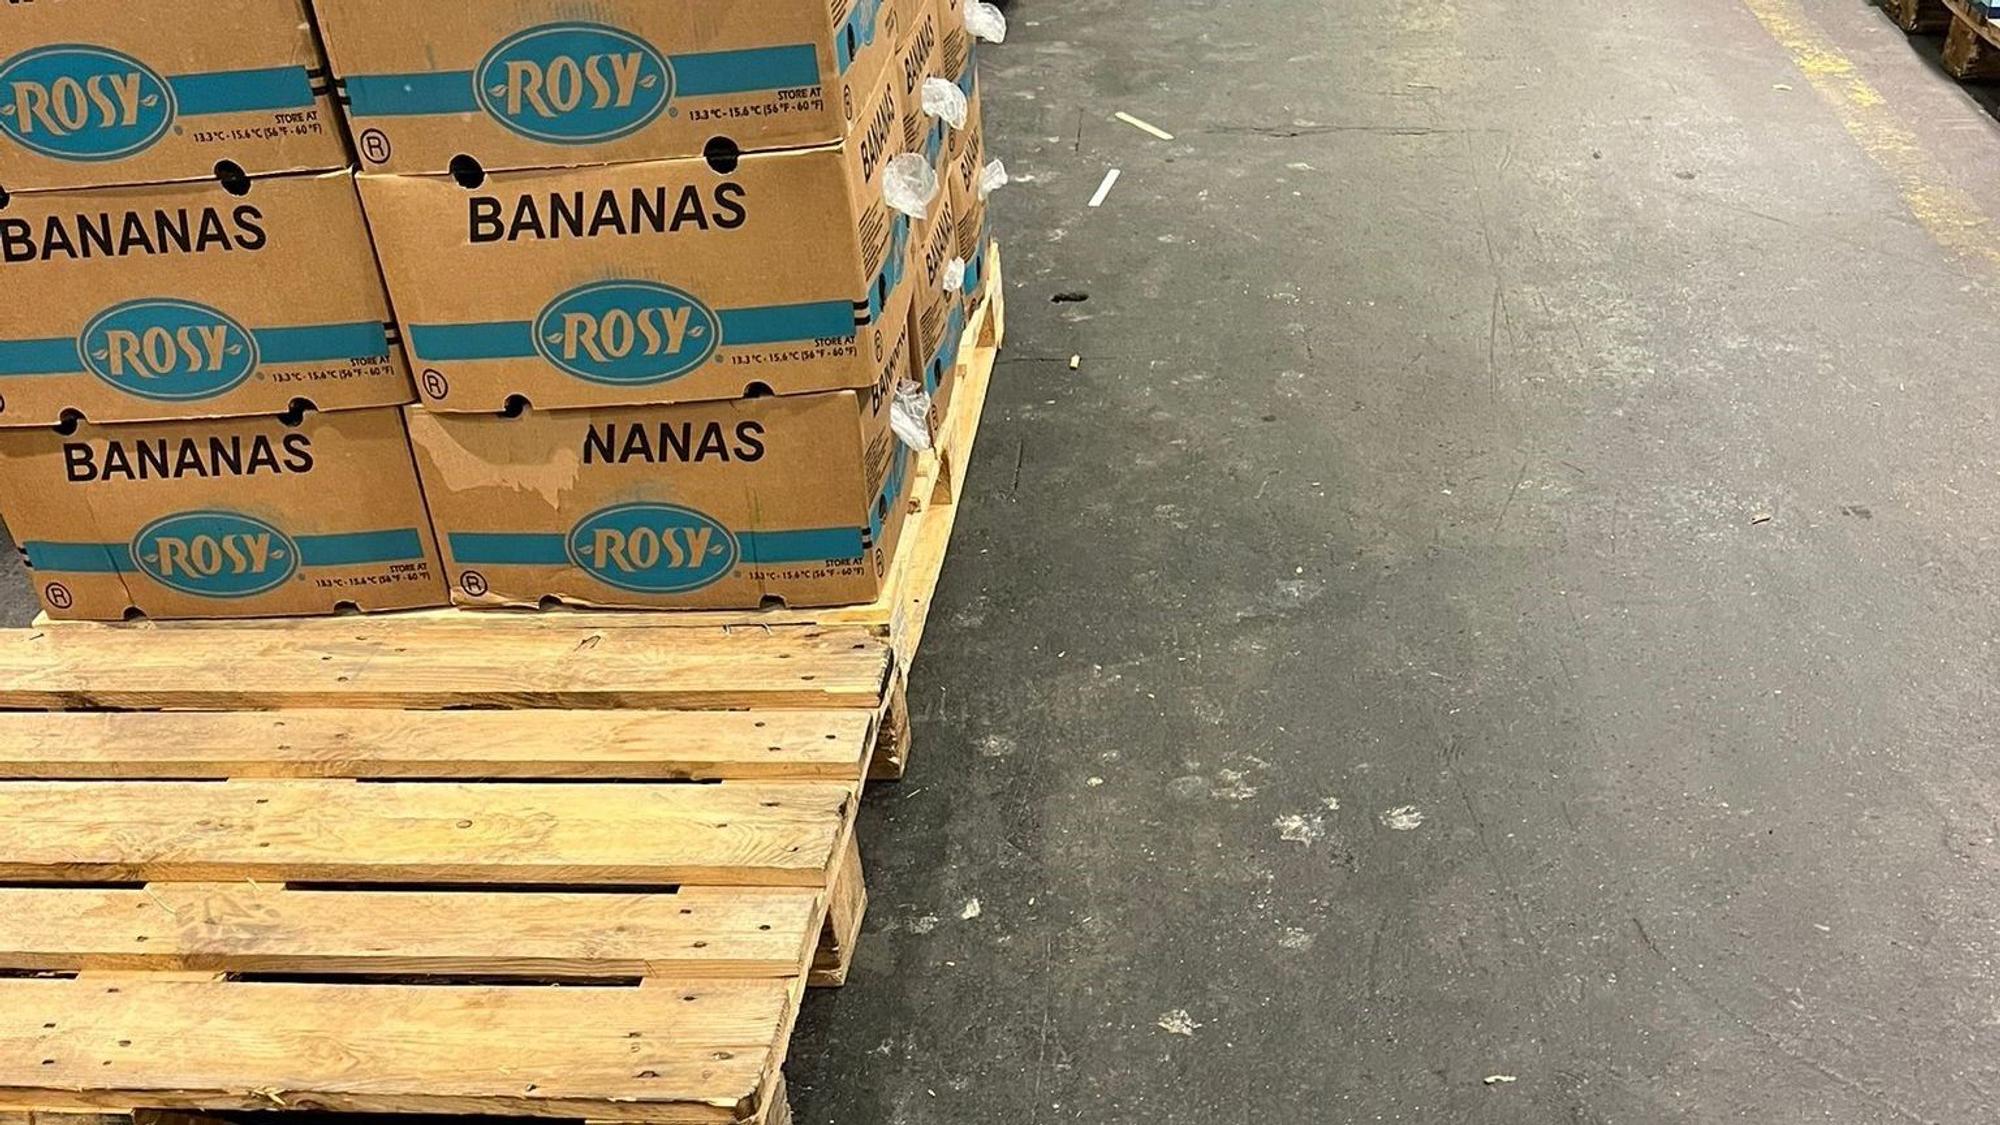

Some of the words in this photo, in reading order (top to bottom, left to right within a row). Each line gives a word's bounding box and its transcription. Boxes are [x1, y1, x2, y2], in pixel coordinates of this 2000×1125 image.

[9, 72, 141, 137] ROSY
[505, 52, 644, 118] ROSY
[777, 88, 808, 101] STORE
[810, 87, 822, 98] AT
[274, 112, 303, 124] STORE
[306, 110, 318, 122] AT
[0, 205, 267, 262] BANANAS
[469, 182, 747, 243] BANANAS
[106, 325, 228, 379] ROSY
[561, 306, 692, 363] ROSY
[814, 336, 842, 348] STORE
[844, 335, 855, 345] AT
[64, 434, 314, 482] BANANAS
[155, 533, 271, 578] ROSY
[592, 527, 712, 573] ROSY
